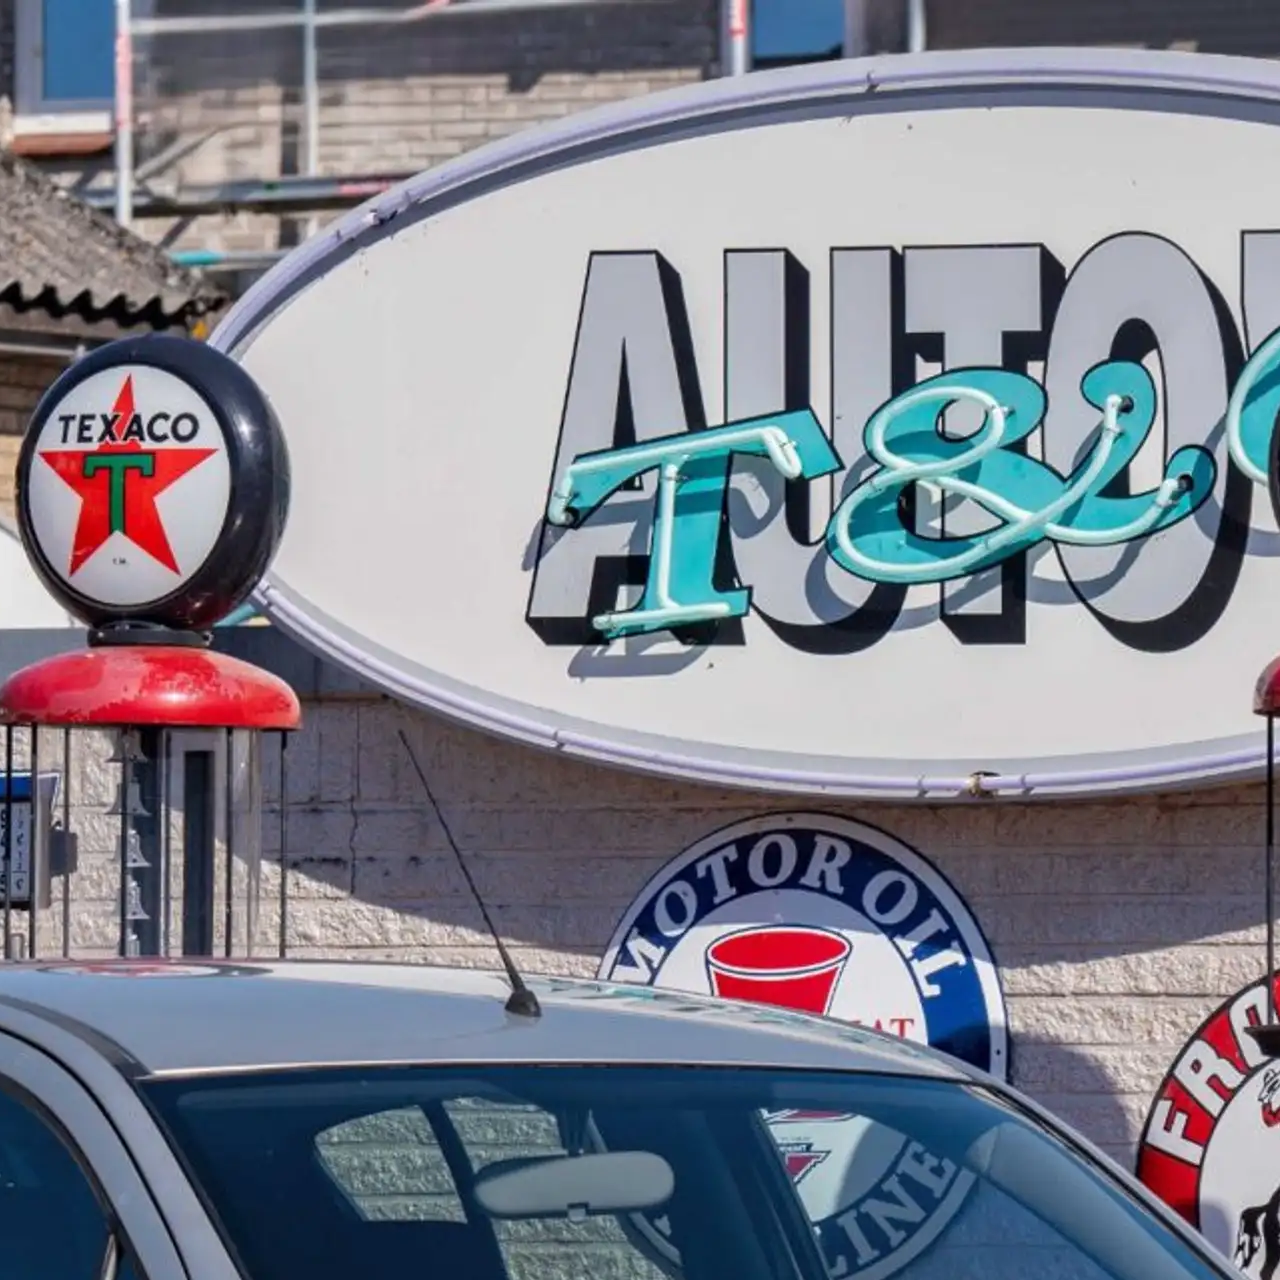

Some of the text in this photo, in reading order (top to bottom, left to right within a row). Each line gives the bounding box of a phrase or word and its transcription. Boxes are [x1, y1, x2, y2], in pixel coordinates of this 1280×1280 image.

[58, 411, 201, 444] TEXACO
[81, 450, 157, 536] T
[609, 833, 967, 999] MOTOR OIL
